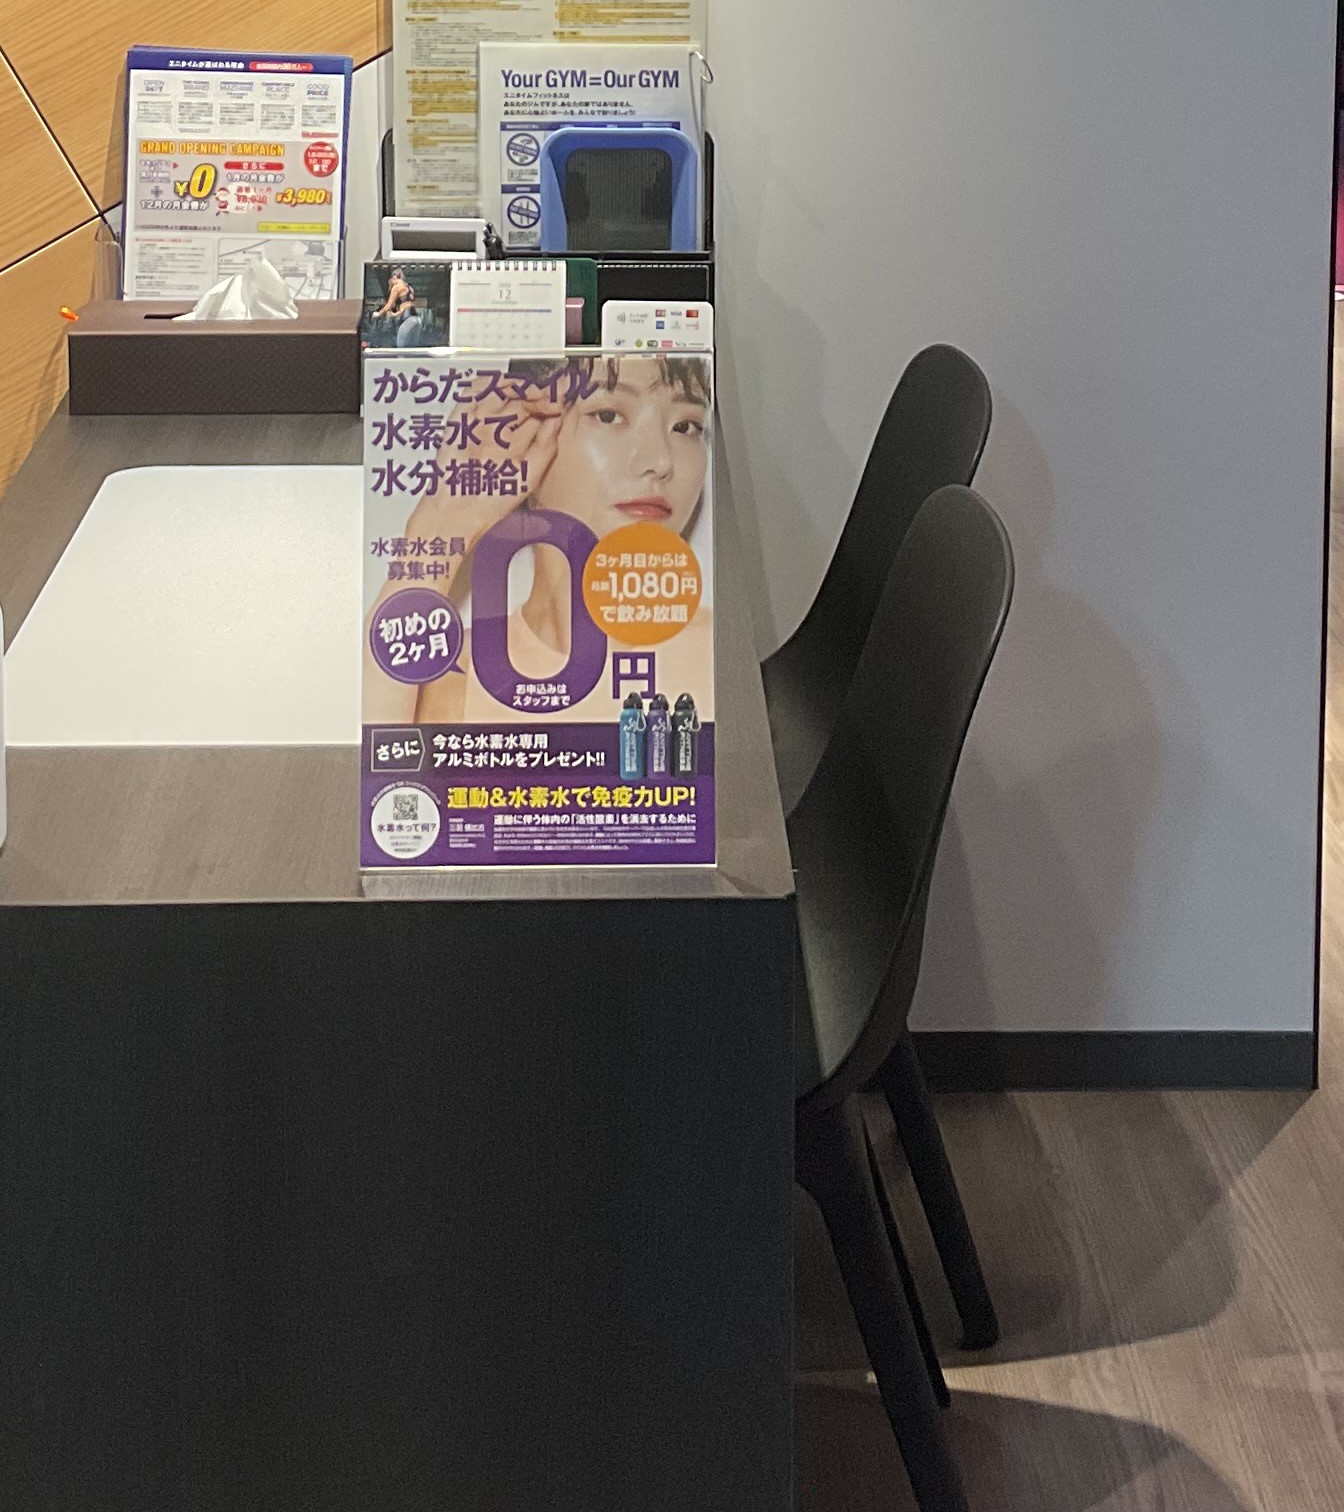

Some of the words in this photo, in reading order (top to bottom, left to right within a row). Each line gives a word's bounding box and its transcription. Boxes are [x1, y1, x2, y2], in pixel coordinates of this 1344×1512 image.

[500, 69, 543, 88] Your
[638, 70, 680, 89] GYM
[140, 140, 176, 155] GRAND
[179, 141, 226, 156] OPENING
[229, 142, 286, 157] CAMPAIGN
[373, 367, 599, 404] からだスマイル
[371, 412, 519, 451] 水素水で
[370, 536, 466, 558] 水素水会員
[379, 607, 451, 644] 初めの
[375, 739, 421, 762] さらに
[431, 733, 548, 751] 今なら水素水専用
